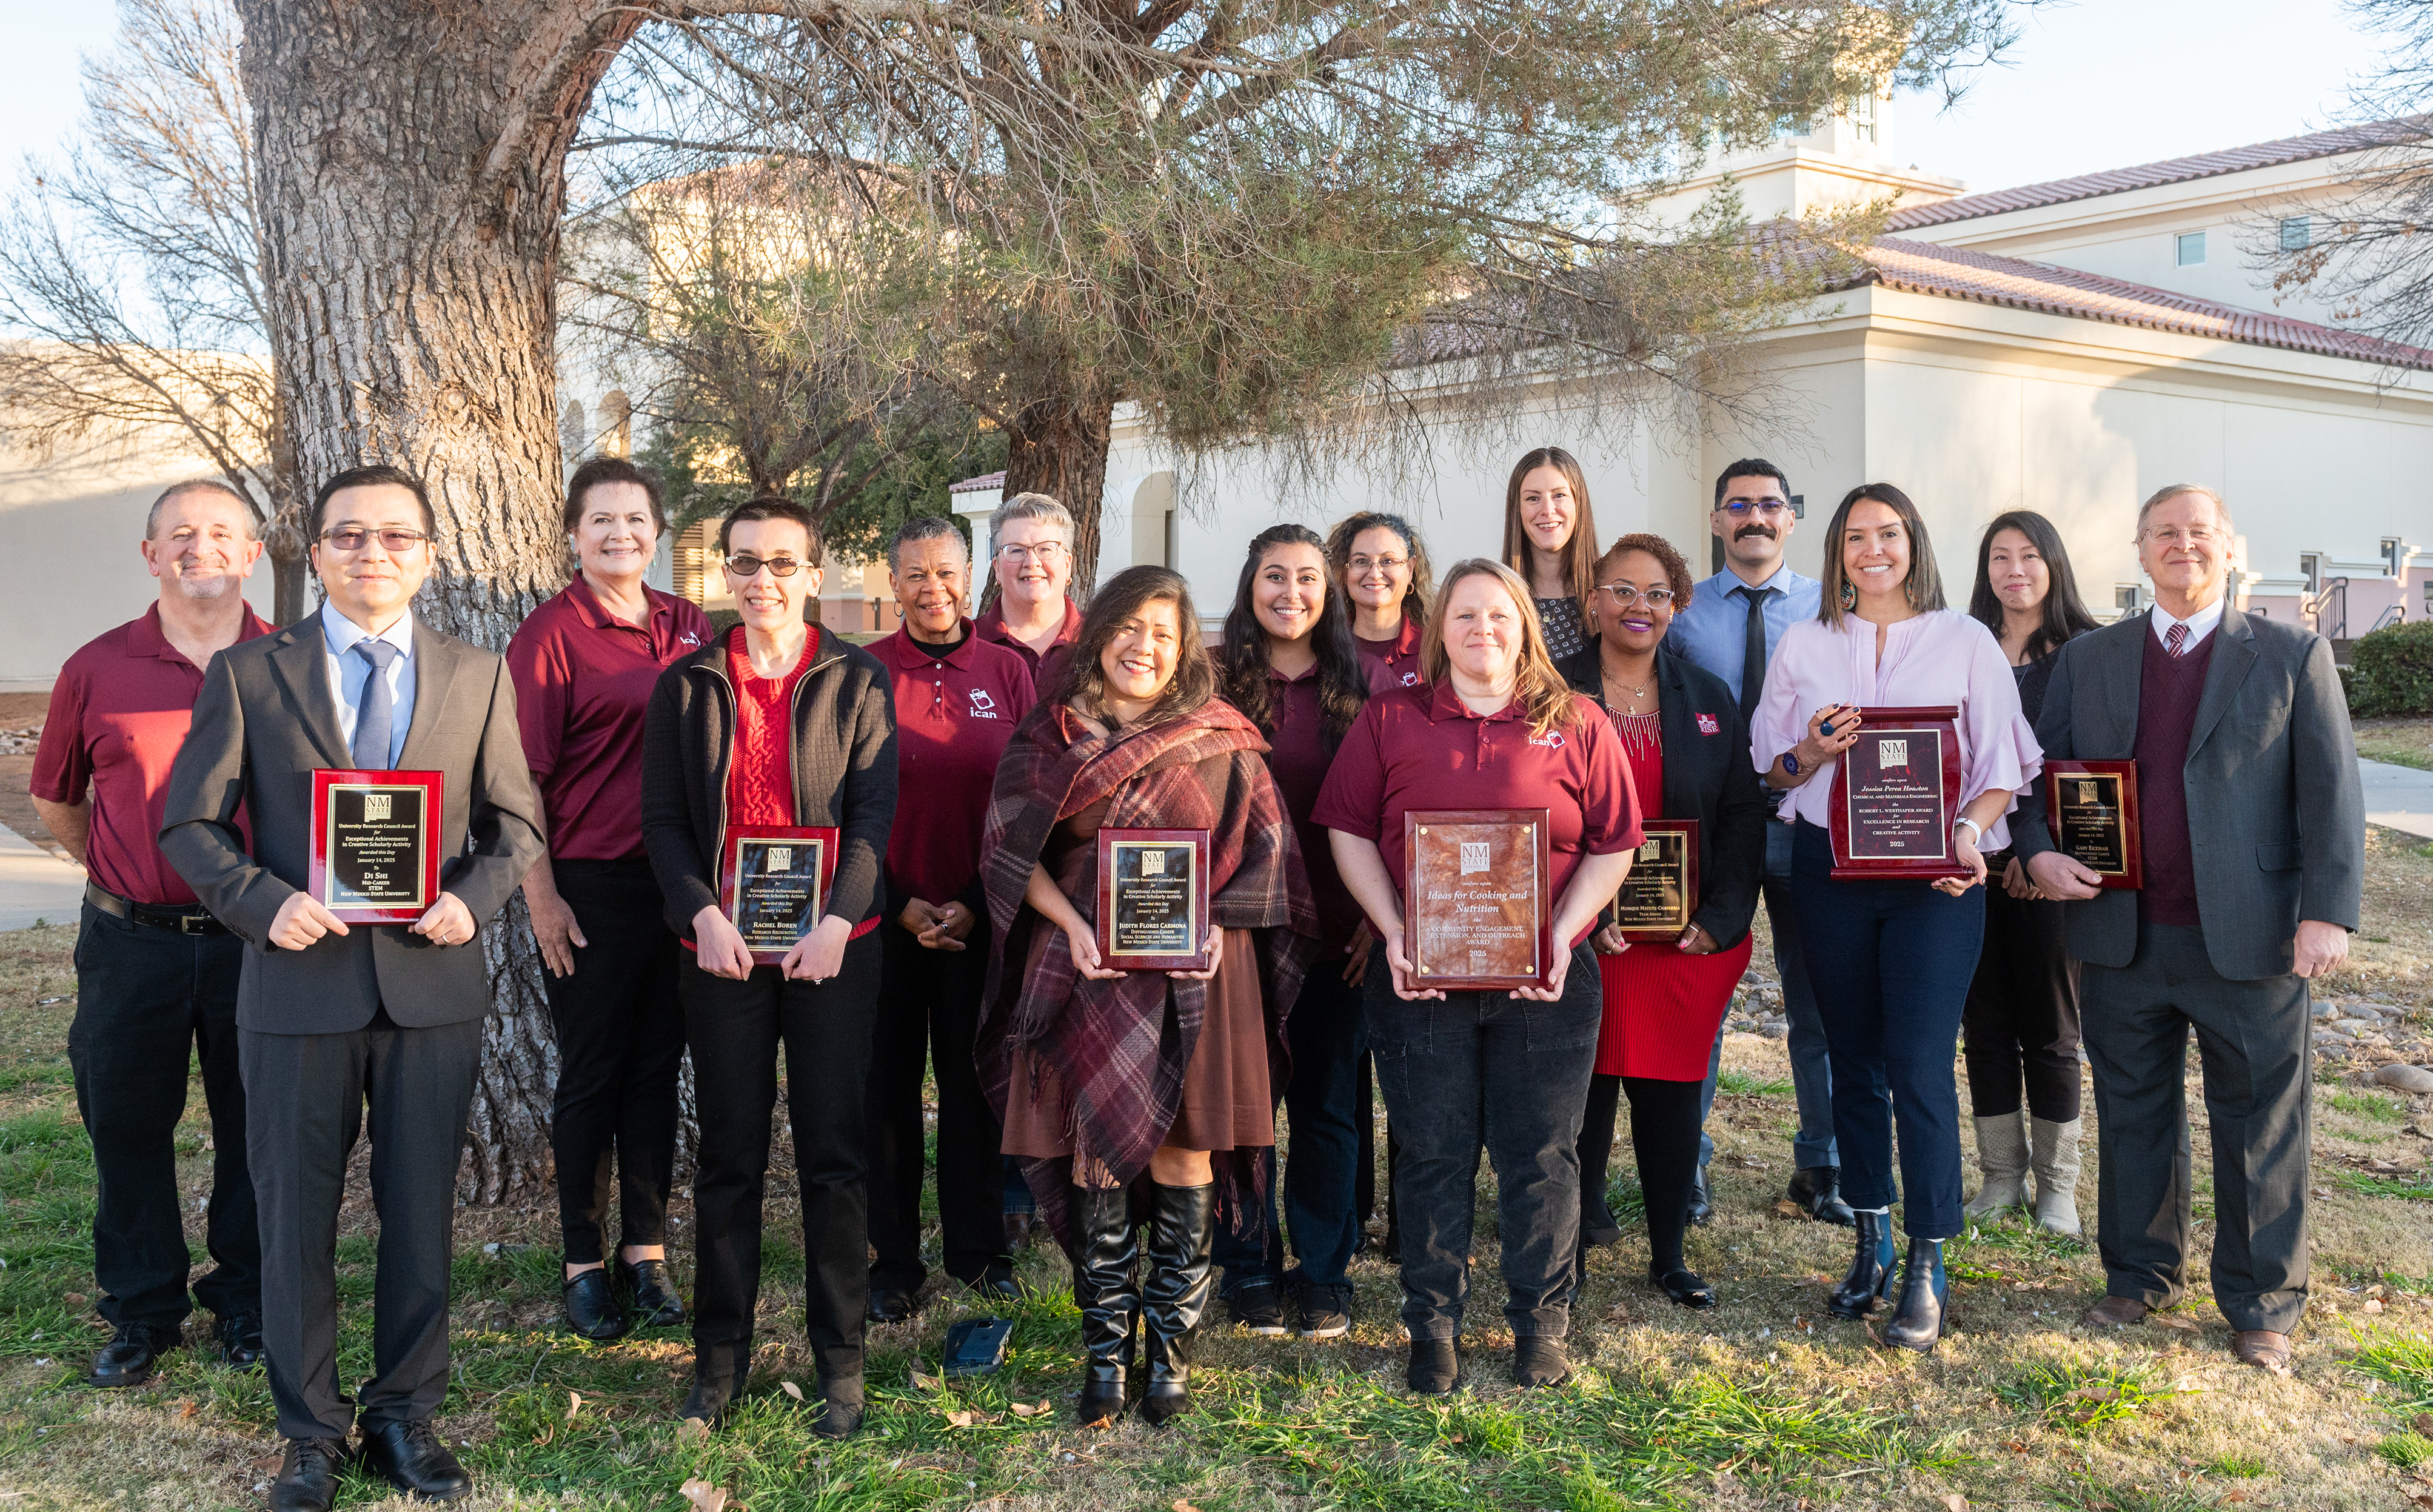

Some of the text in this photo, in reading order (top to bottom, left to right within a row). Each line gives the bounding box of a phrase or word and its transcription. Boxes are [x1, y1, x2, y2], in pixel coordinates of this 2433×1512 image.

[970, 707, 997, 718] ican
[1529, 736, 1550, 746] ican
[1881, 743, 1906, 753] NM
[367, 797, 390, 807] NM
[1641, 841, 1658, 850] NM
[770, 850, 789, 858] NM
[1462, 846, 1488, 857] NM
[1144, 854, 1163, 862] NM
[1428, 891, 1527, 902] Ideas for Cooking and
[1456, 905, 1499, 913] Nutrition
